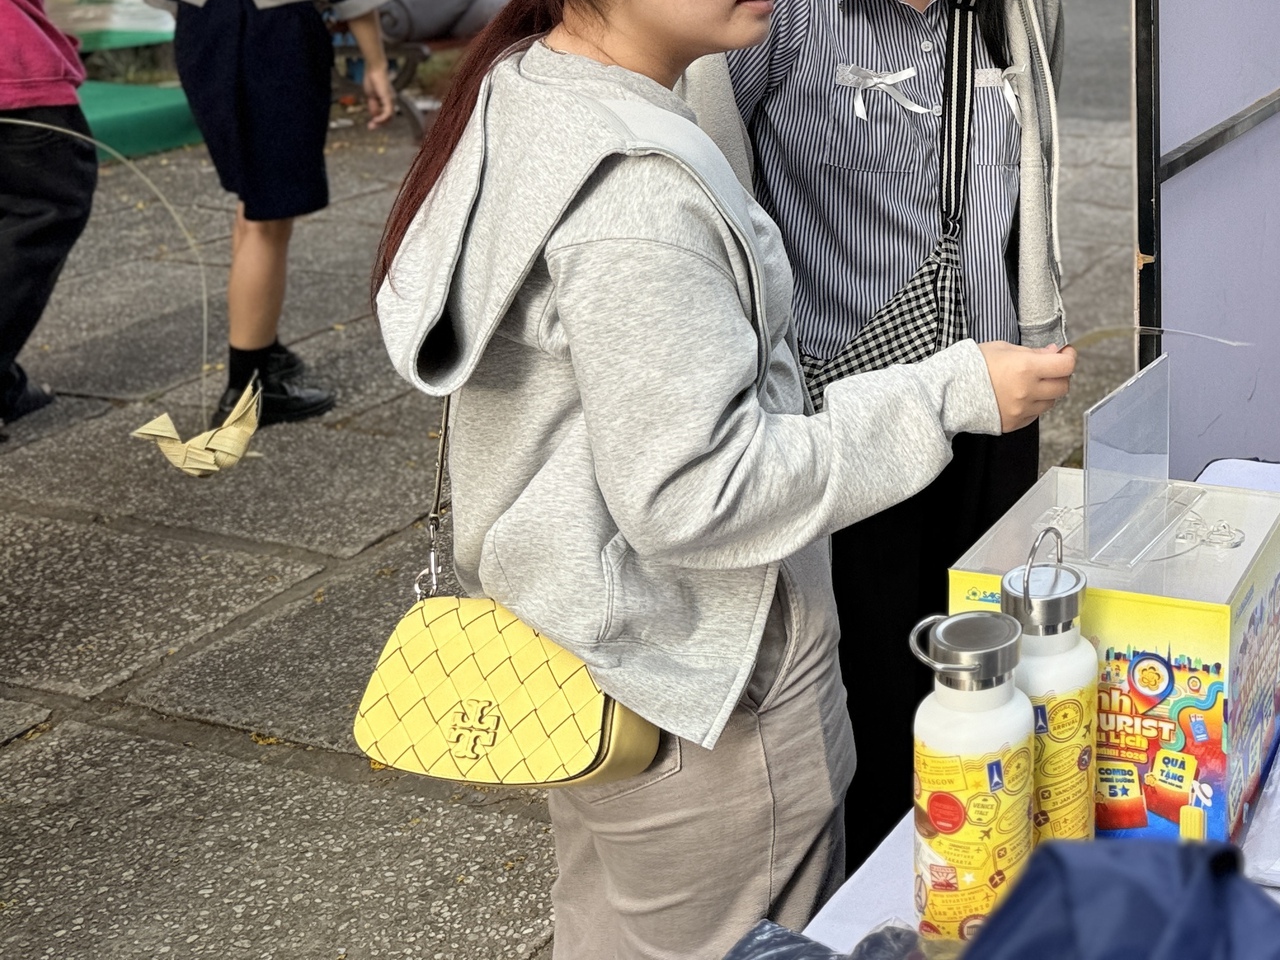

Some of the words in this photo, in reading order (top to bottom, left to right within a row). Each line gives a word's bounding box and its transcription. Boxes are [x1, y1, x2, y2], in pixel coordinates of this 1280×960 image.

[1052, 718, 1078, 731] ARRIVAL
[1108, 730, 1148, 749] Lịch
[1120, 750, 1147, 761] 2026
[1162, 756, 1186, 771] QUÀ
[1098, 767, 1134, 777] COMBO
[1160, 769, 1184, 783] TẶNG
[921, 776, 955, 786] GLASGOW
[1055, 776, 1086, 796] VANCOUVER
[1060, 795, 1071, 804] JAN
[945, 856, 972, 866] JAKARTA
[952, 903, 990, 916] ANTONIO
